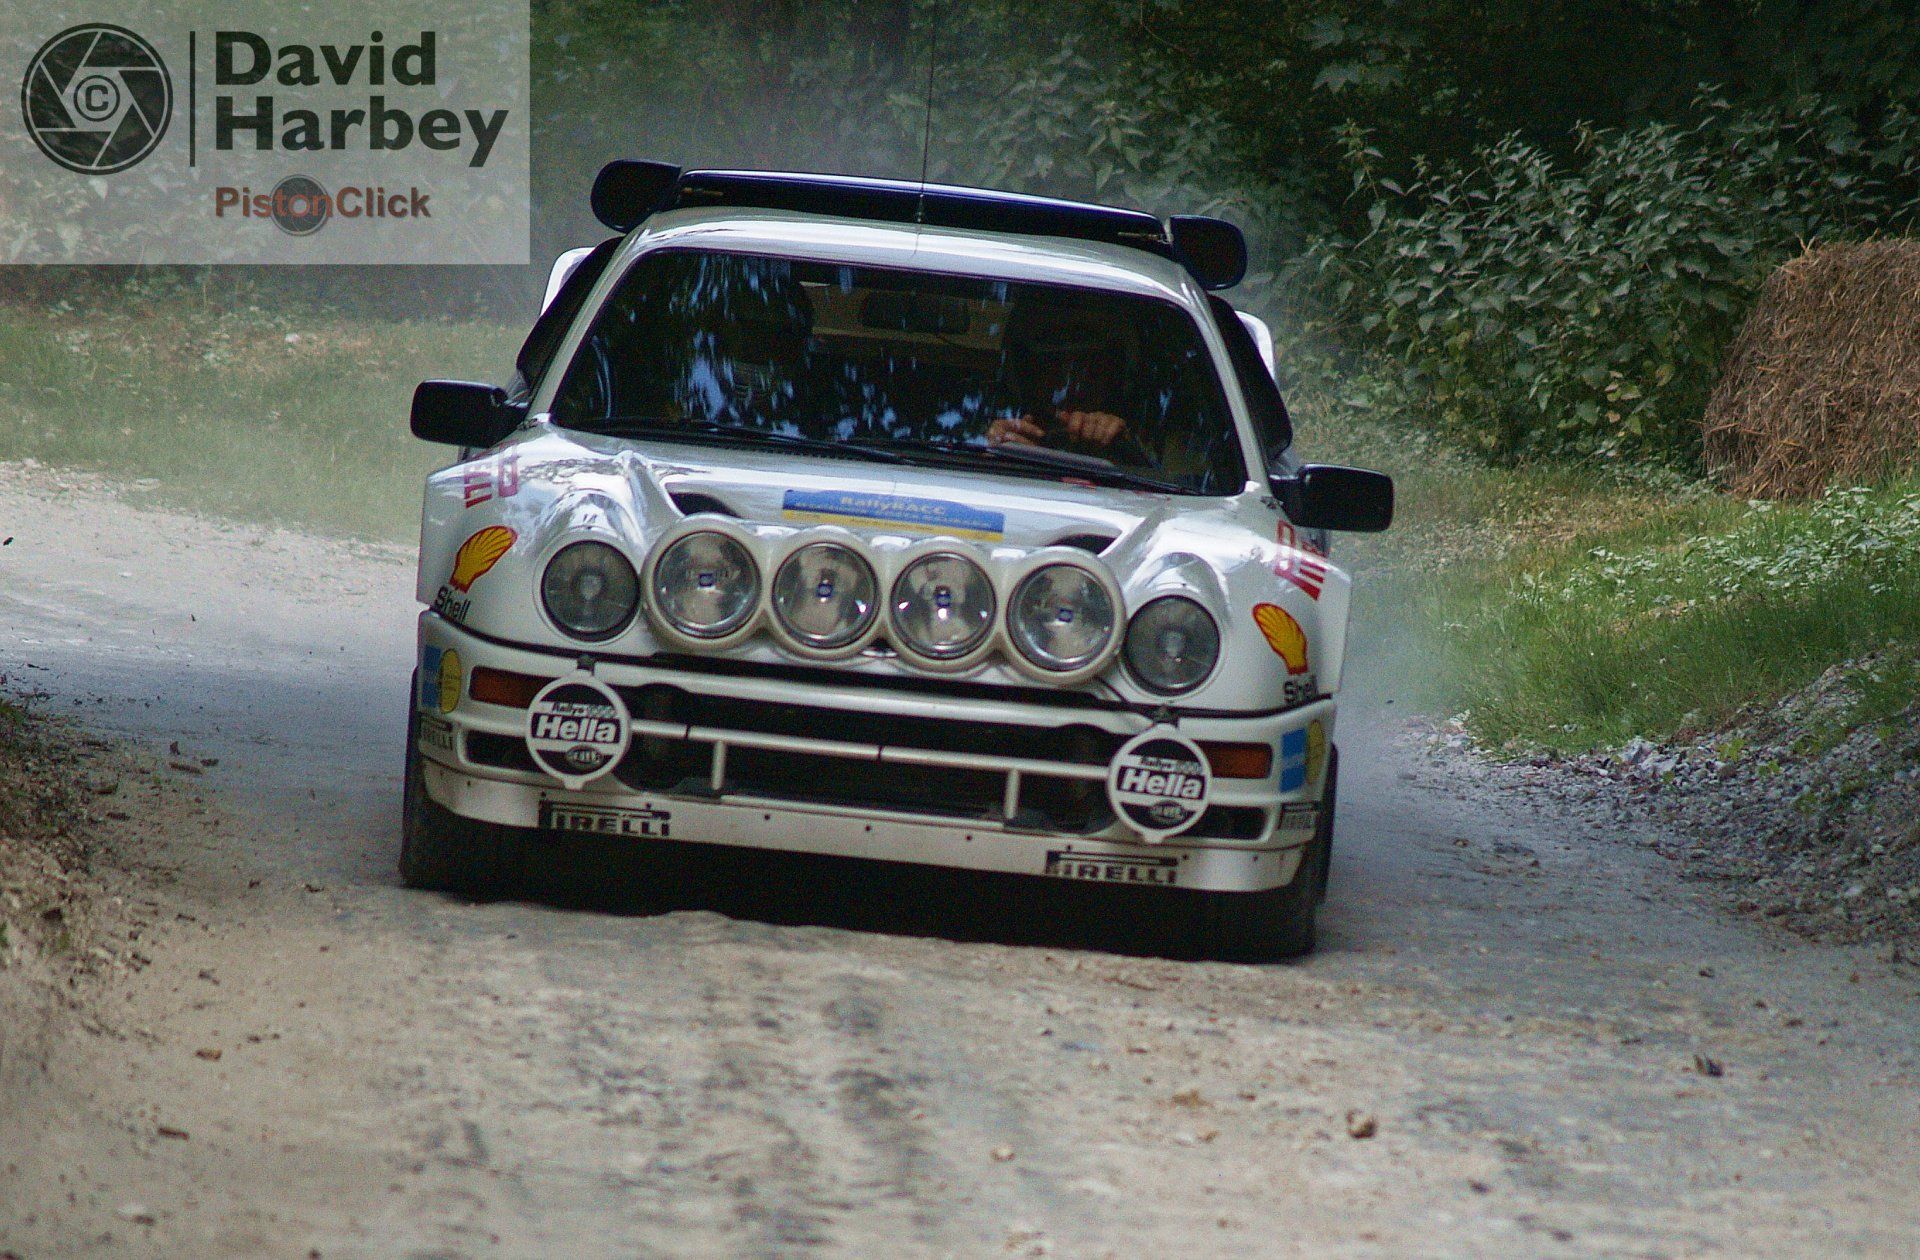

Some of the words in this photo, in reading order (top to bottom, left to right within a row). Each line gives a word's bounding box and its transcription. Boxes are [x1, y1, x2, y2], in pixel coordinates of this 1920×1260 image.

[433, 585, 472, 624] Shell
[535, 714, 618, 743] Hella
[1121, 768, 1202, 799] Hella
